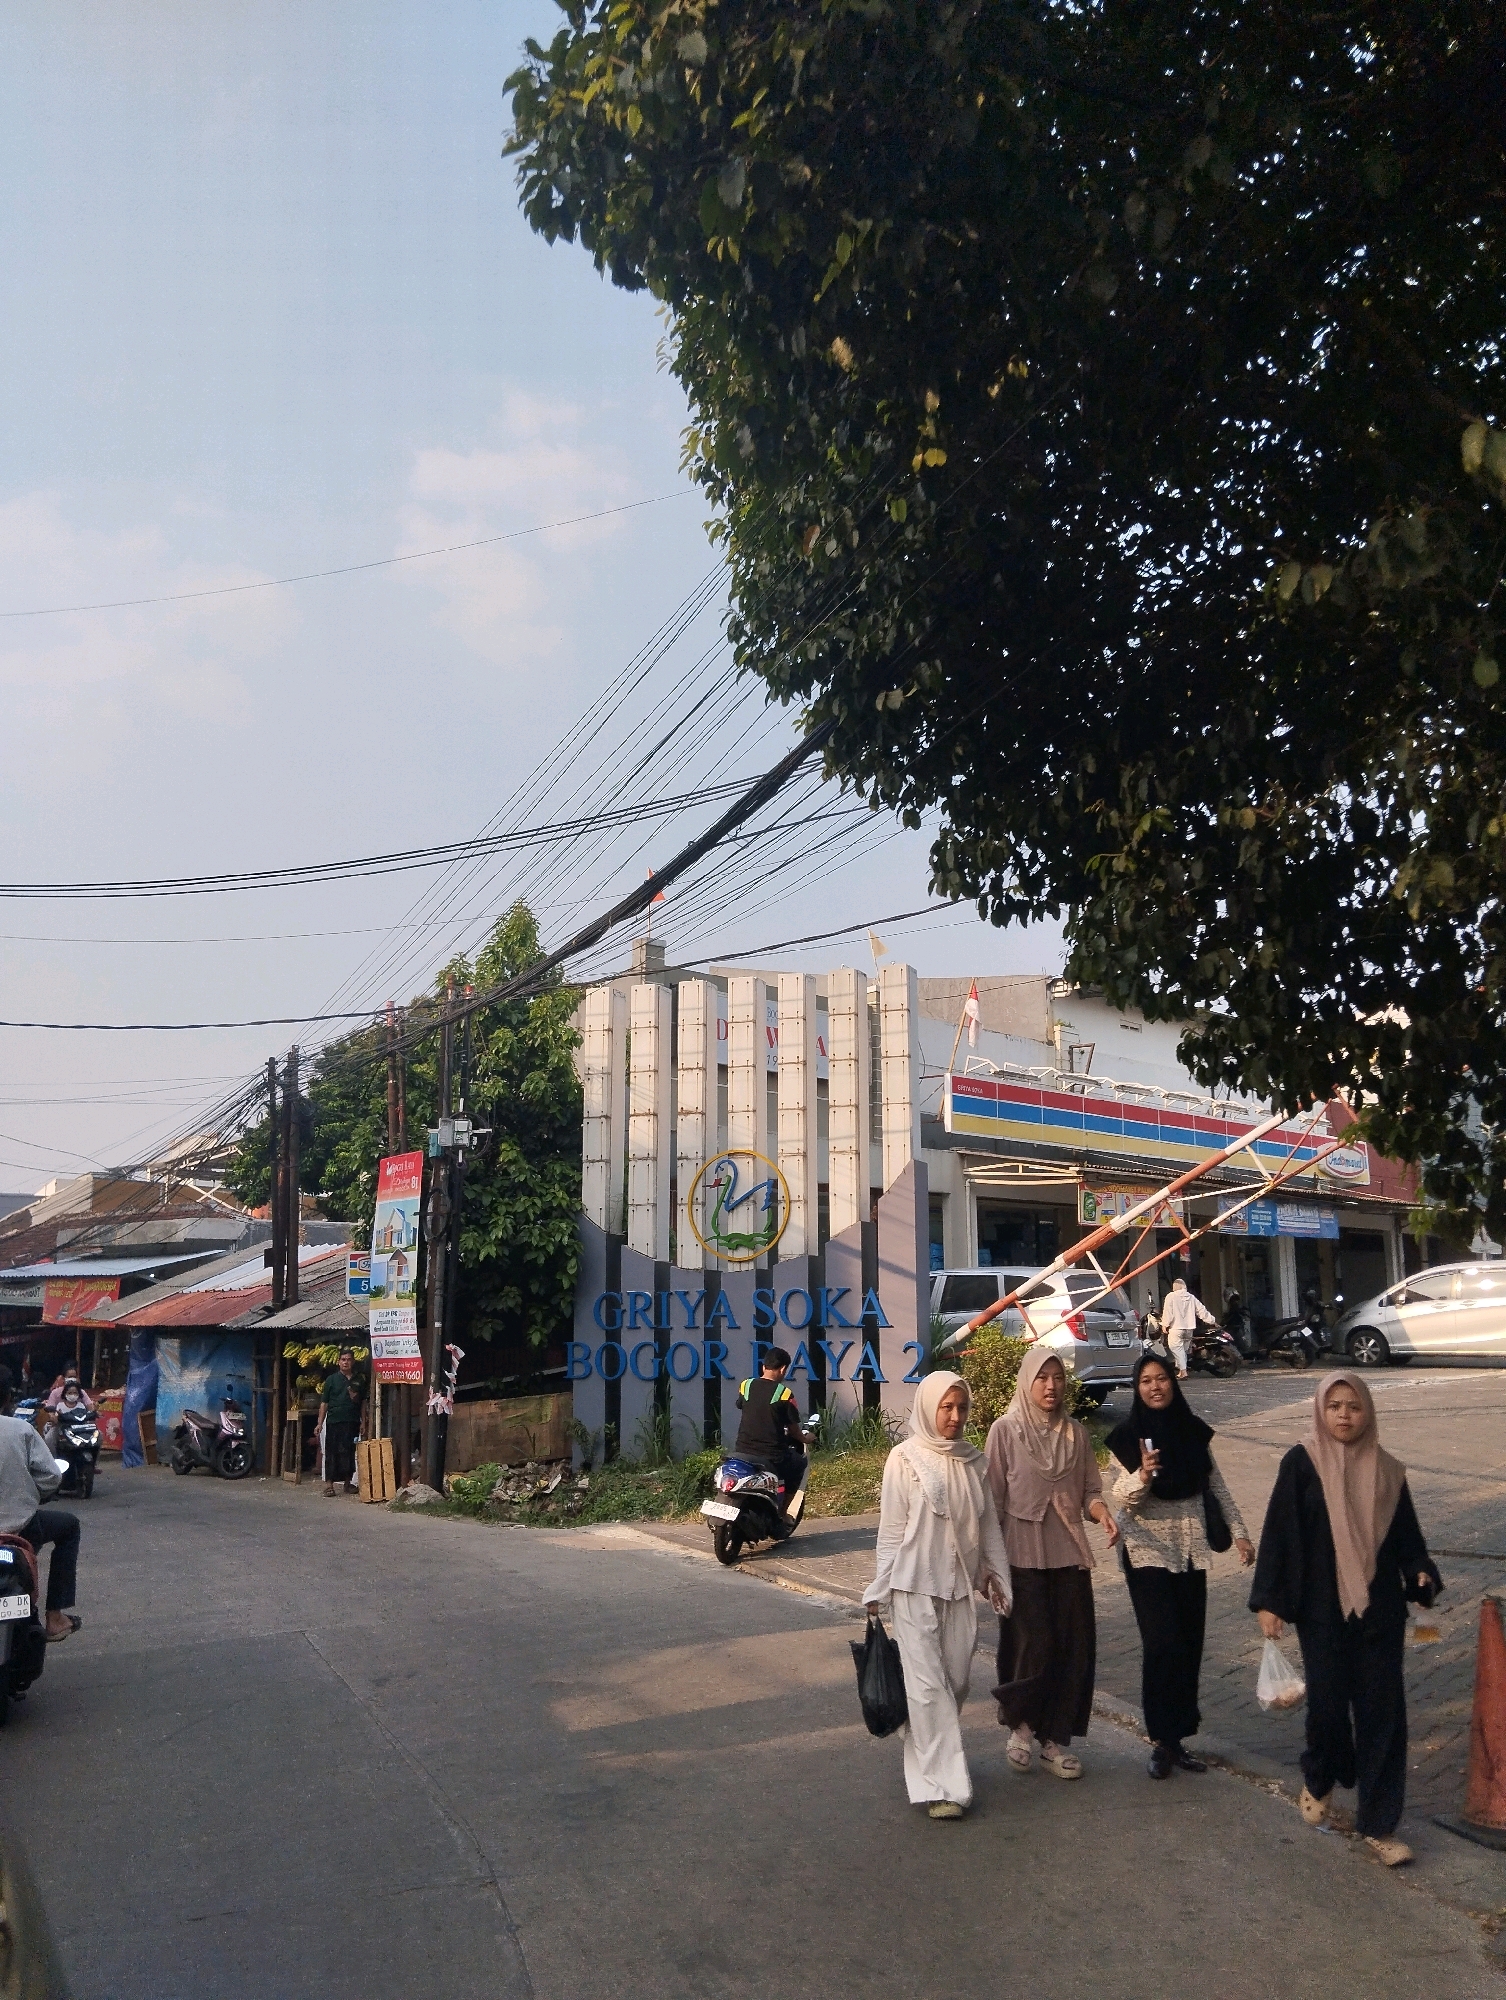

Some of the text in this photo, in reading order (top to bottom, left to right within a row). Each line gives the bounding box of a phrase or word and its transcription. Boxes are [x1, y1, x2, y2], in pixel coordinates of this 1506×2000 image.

[592, 1287, 895, 1331] GRIYA SOKA
[563, 1340, 736, 1383] BOGOR
[902, 1341, 926, 1384] 2
[17, 1596, 28, 1606] DK
